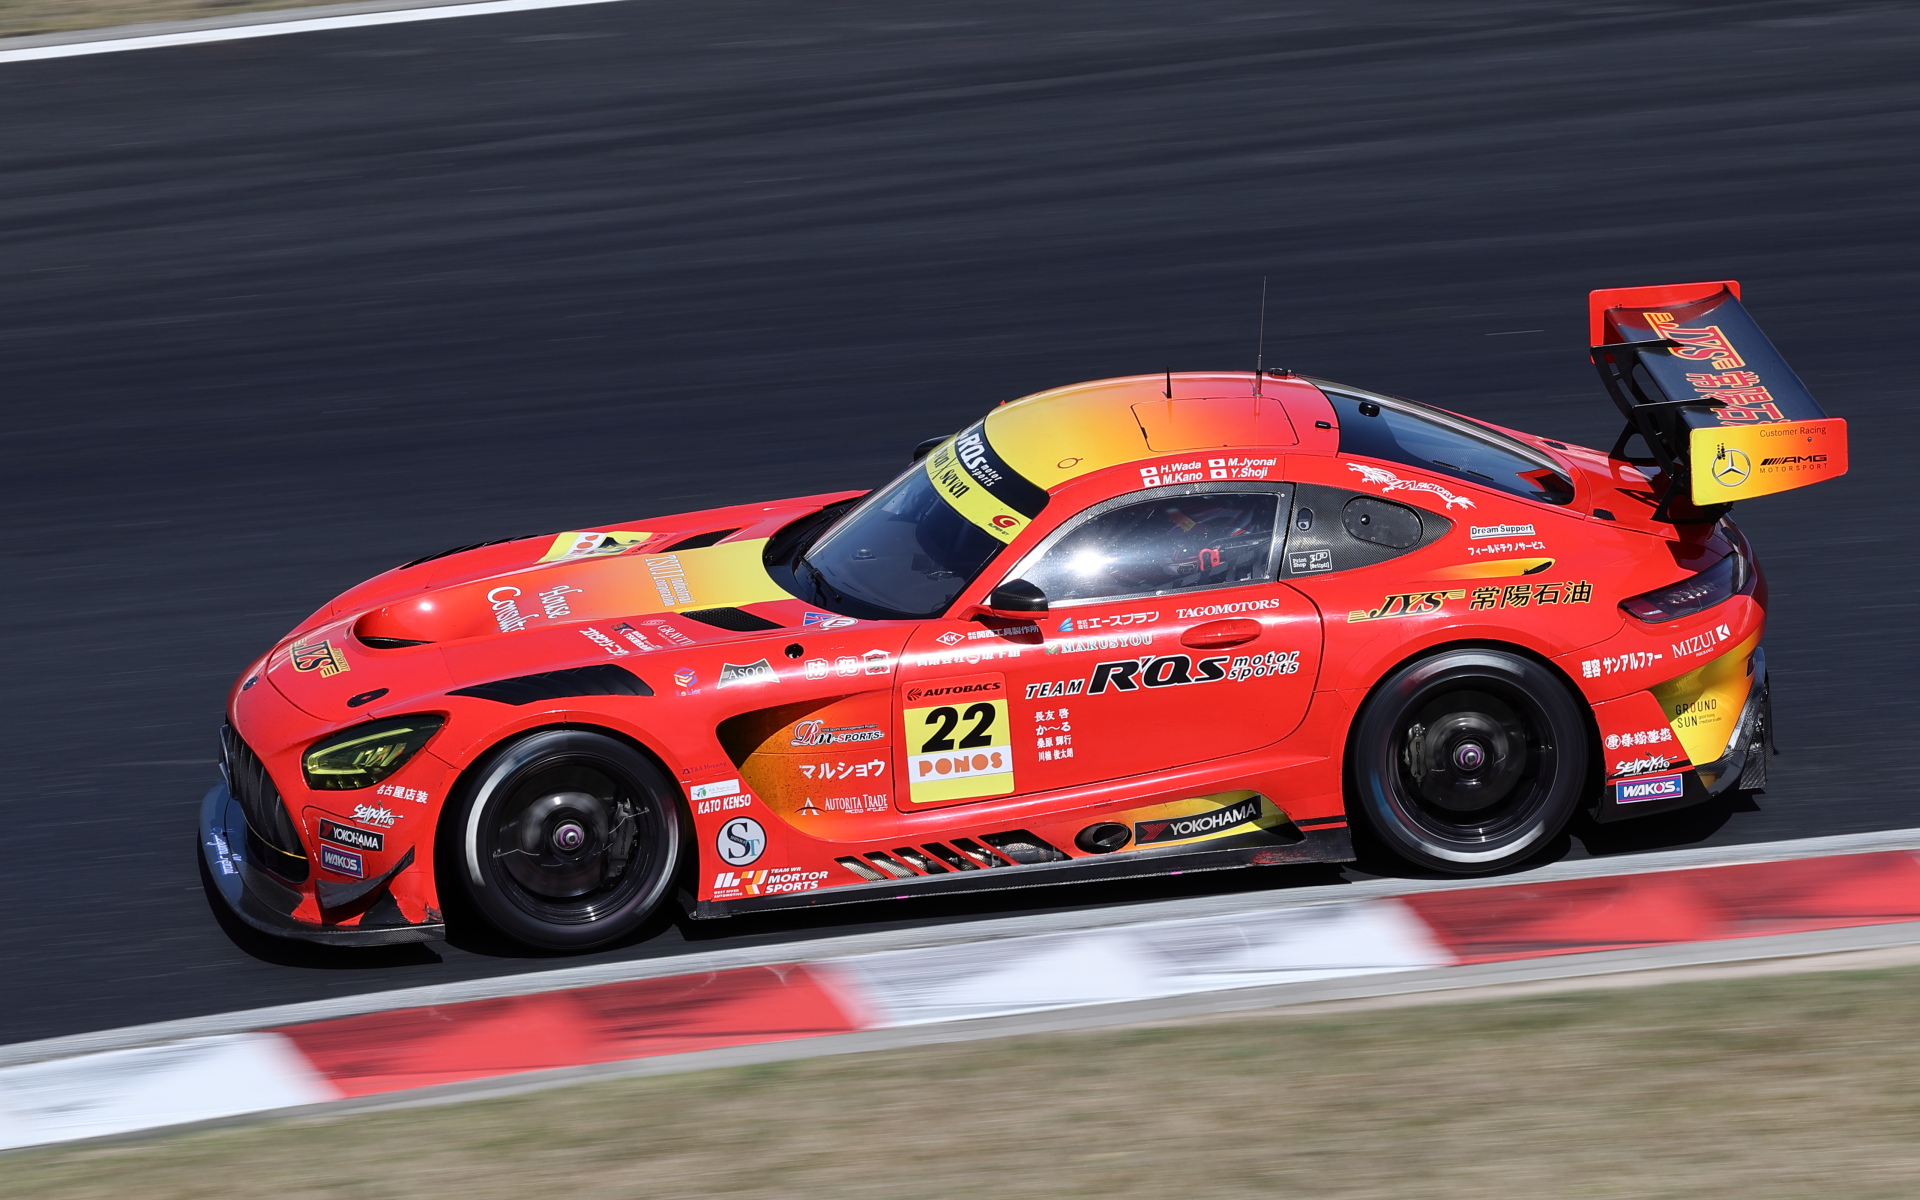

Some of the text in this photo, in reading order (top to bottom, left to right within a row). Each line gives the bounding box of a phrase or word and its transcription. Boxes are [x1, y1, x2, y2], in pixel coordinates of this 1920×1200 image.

[1685, 371, 1790, 425] 常陽石
[1759, 426, 1827, 438] Customer Racing
[1160, 461, 1202, 474] H.Wada
[1227, 457, 1277, 470] M.Jyonai
[1759, 463, 1829, 474] MOTORSPORT
[1782, 454, 1828, 465] AMG
[971, 468, 995, 488] sports
[980, 463, 1003, 481] motor
[1162, 472, 1203, 485] M.Kano
[1230, 467, 1269, 479] Y.Shoji
[939, 468, 970, 499] seven
[1415, 481, 1456, 500] FACTORY
[1471, 525, 1533, 535] Dream Support
[538, 585, 584, 619] House
[1468, 580, 1594, 611] 常陽石油
[1176, 598, 1280, 619] TAGOMOTORS
[1061, 634, 1153, 654] MARUSYOU
[1671, 630, 1717, 659] MIZUI
[1232, 650, 1300, 668] motor
[1581, 651, 1663, 679] 理容 サンアルファー
[1228, 660, 1300, 682] sports
[923, 682, 1001, 698] AUTOBACS
[1025, 679, 1085, 699] TEAM
[1675, 699, 1717, 715] GROUND
[921, 702, 996, 753] 22
[1677, 716, 1698, 729] SUN
[798, 758, 886, 780] マルショウ
[918, 751, 1003, 777] PONOS
[376, 784, 429, 804] 名古屋店装
[697, 793, 752, 815] KATO KENSO
[825, 797, 862, 811] AUTORITA
[862, 794, 888, 808] TRADE
[1169, 802, 1257, 836] YOKOHAMA
[333, 826, 379, 850] YOKOHAMA
[765, 880, 819, 894] SPORTS
[767, 871, 829, 884] MORTOR
